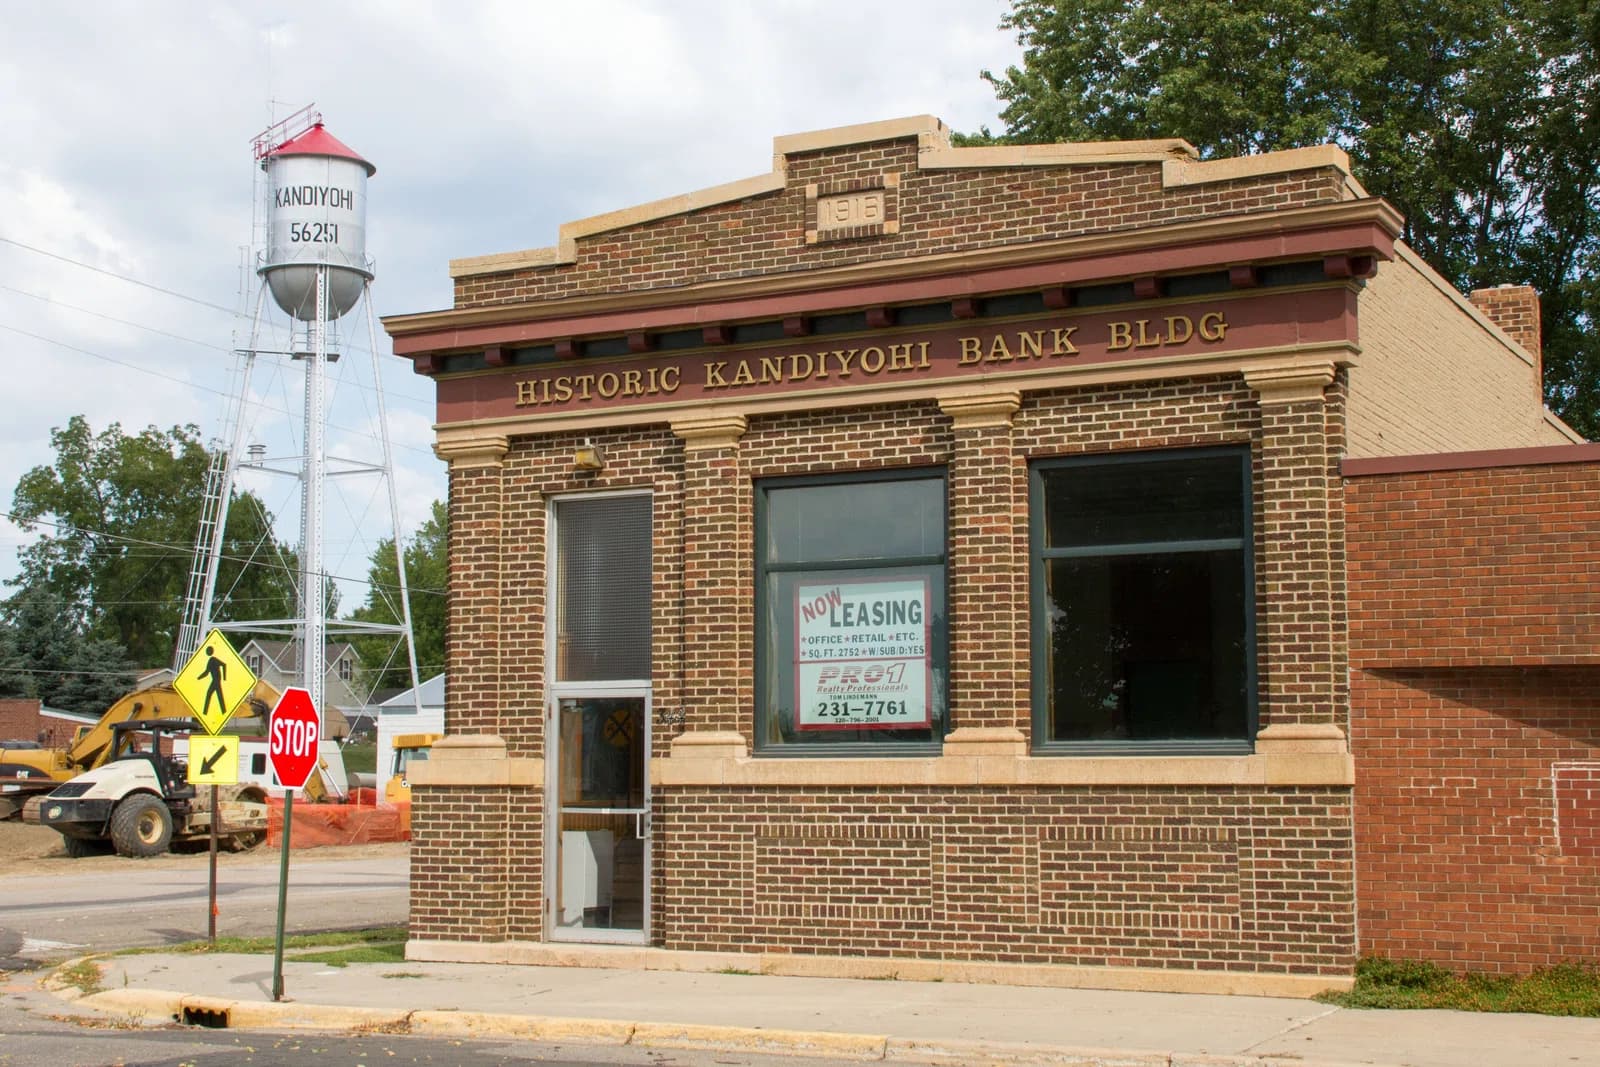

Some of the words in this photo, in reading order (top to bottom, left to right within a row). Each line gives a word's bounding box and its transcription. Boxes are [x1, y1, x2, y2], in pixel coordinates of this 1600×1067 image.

[275, 185, 353, 211] KANDIYOHI
[826, 196, 878, 224] 1916
[291, 222, 338, 244] 56251
[515, 366, 681, 406] HISTORIC
[703, 341, 931, 389] KANDIYOHI
[958, 327, 1080, 364] BANK
[1106, 311, 1228, 350] BLDG
[801, 587, 842, 624] NOW
[830, 599, 922, 628] LEASING
[808, 635, 843, 645] OFFICE
[851, 633, 887, 643] RETAIL
[895, 632, 919, 641] ETC.
[839, 647, 859, 657] 2752
[817, 686, 844, 694] Realty
[847, 684, 909, 693] Professionals
[818, 700, 908, 717] 231-7761
[272, 717, 317, 757] STOP
